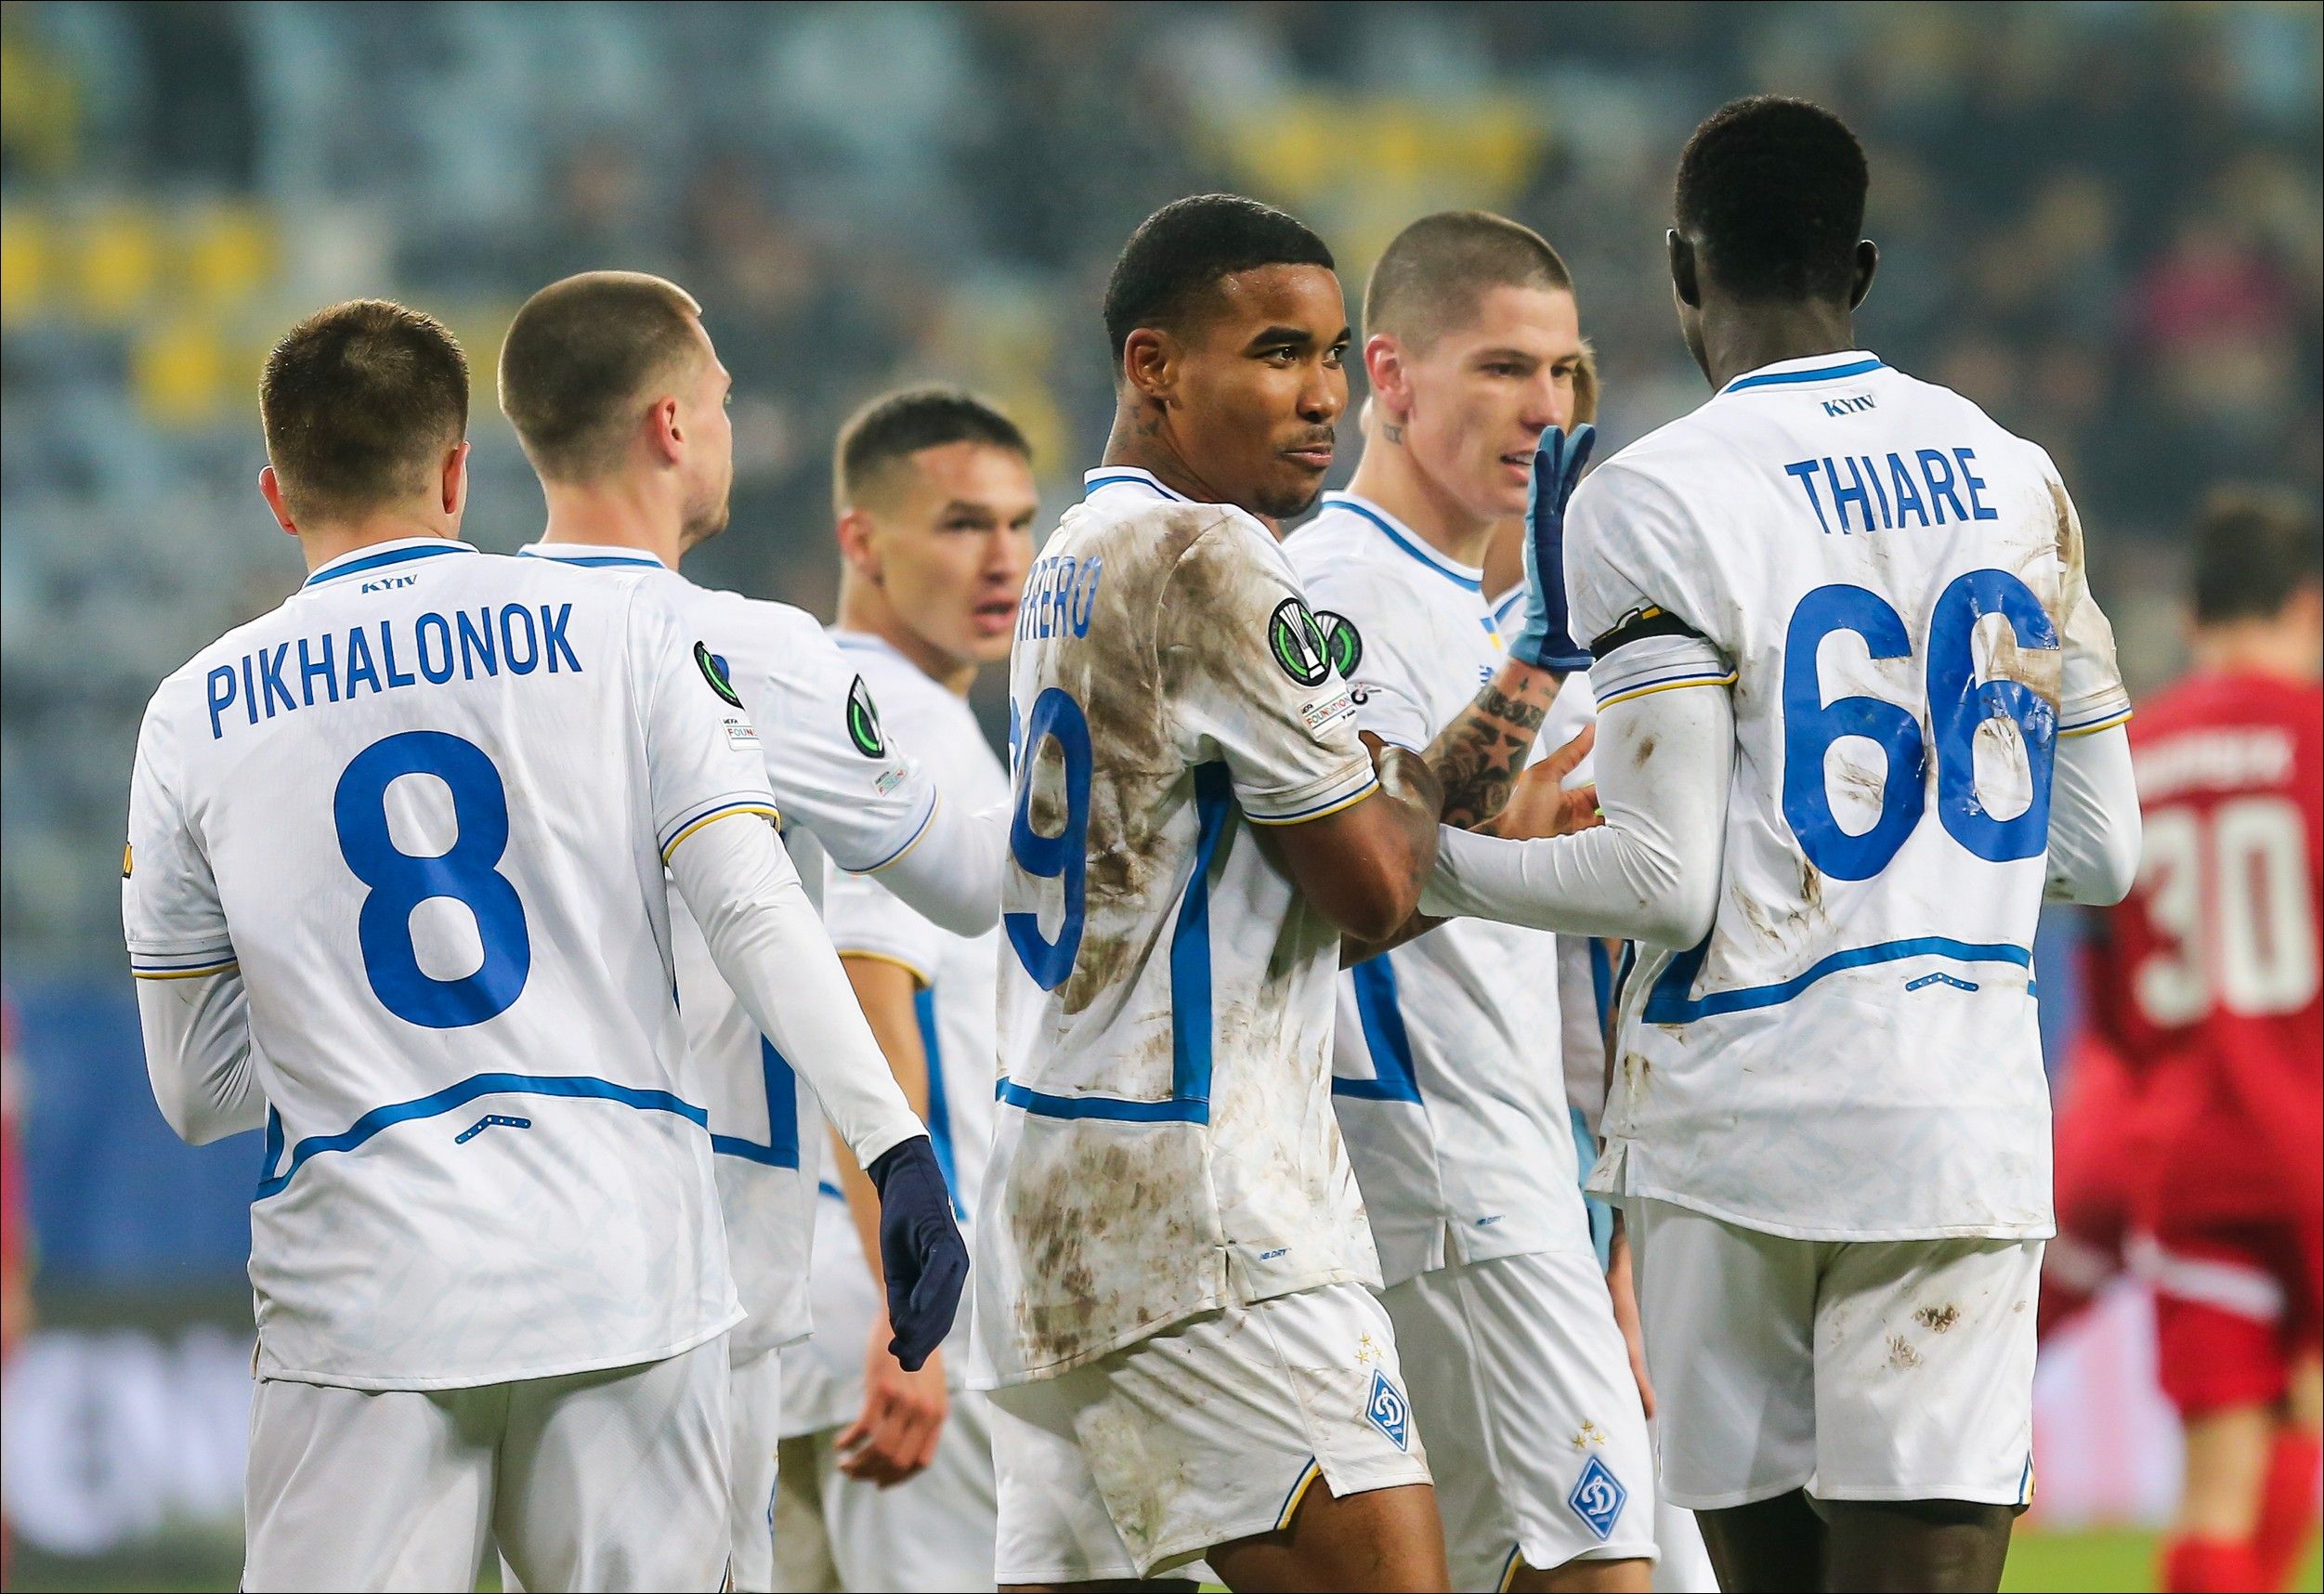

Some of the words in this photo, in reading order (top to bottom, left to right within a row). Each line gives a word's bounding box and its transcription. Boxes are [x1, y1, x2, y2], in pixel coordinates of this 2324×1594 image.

[1784, 447, 1999, 534] THIARE
[1821, 394, 1876, 417] KYIV
[206, 602, 583, 739] PIKHALONOK
[361, 574, 417, 594] KYIV
[1782, 568, 2062, 882] 66
[333, 730, 531, 1029] 8
[1004, 687, 1093, 991] 9
[2135, 797, 2319, 1028] 30
